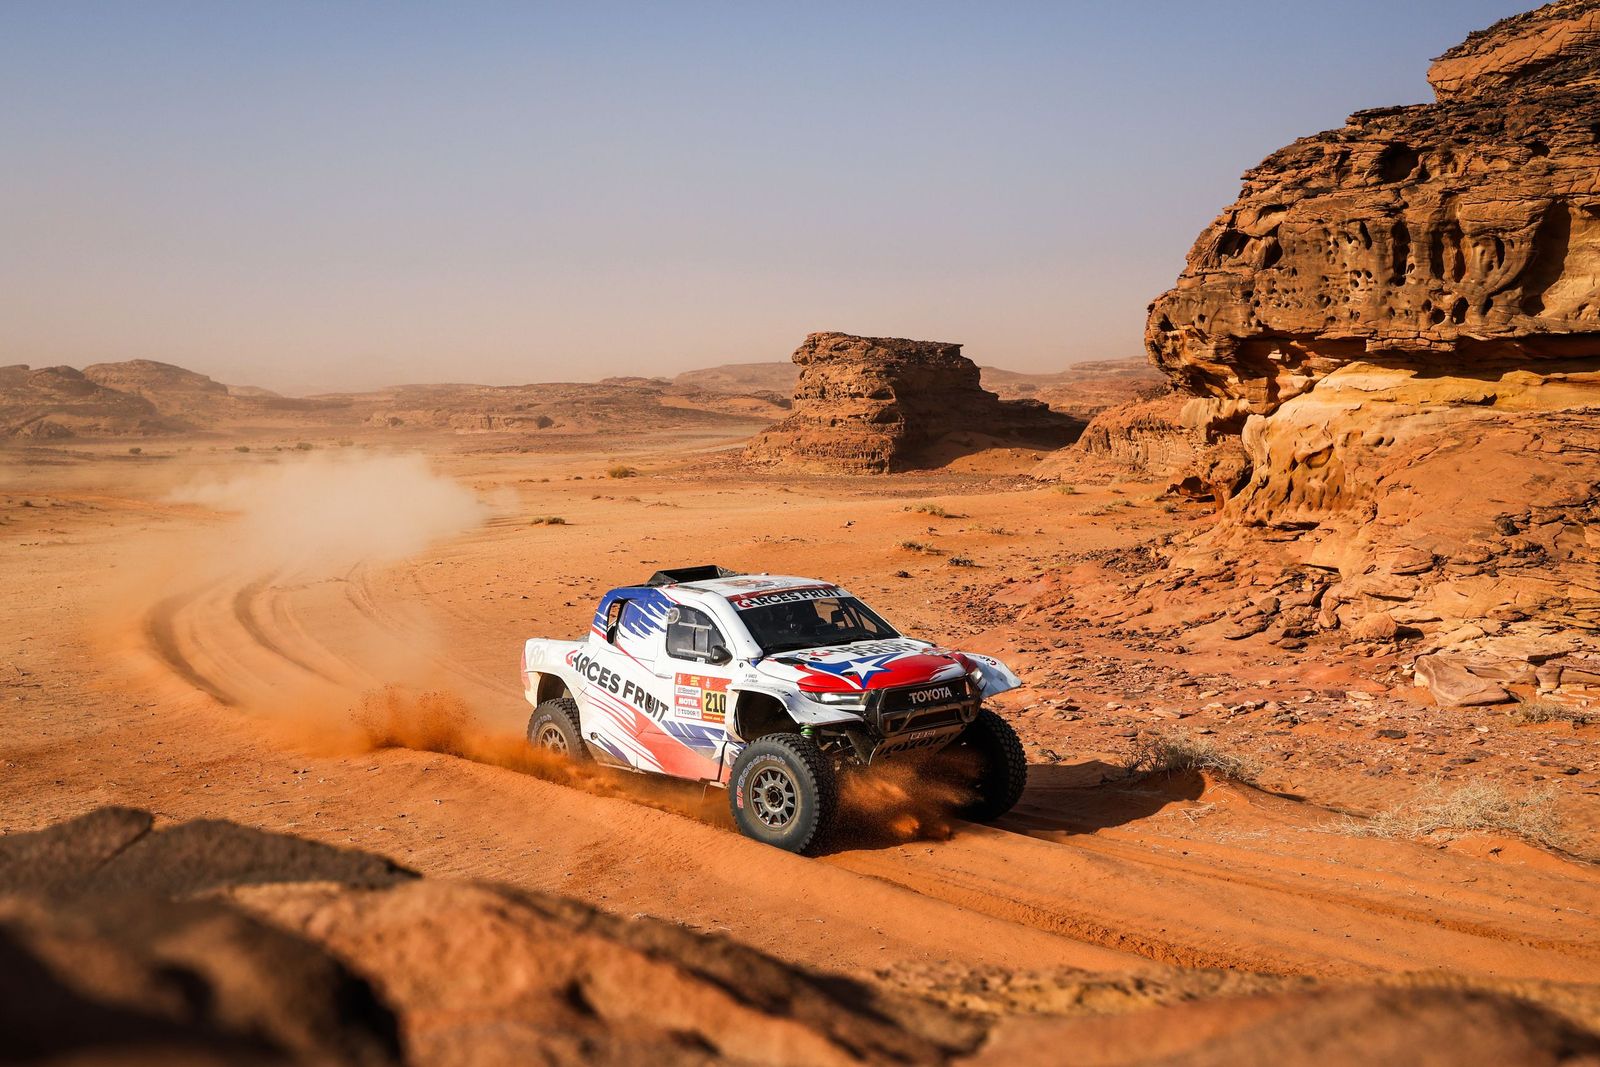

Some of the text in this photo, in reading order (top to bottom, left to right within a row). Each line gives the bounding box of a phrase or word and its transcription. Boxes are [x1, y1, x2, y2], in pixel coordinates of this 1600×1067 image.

[737, 591, 801, 608] GARCES
[801, 588, 841, 600] FRUIT
[565, 649, 669, 724] GARCES FRUIT
[909, 686, 953, 704] TOYOTA
[678, 697, 698, 707] MOTUL
[705, 692, 727, 714] 210
[681, 709, 697, 717] TUDOR
